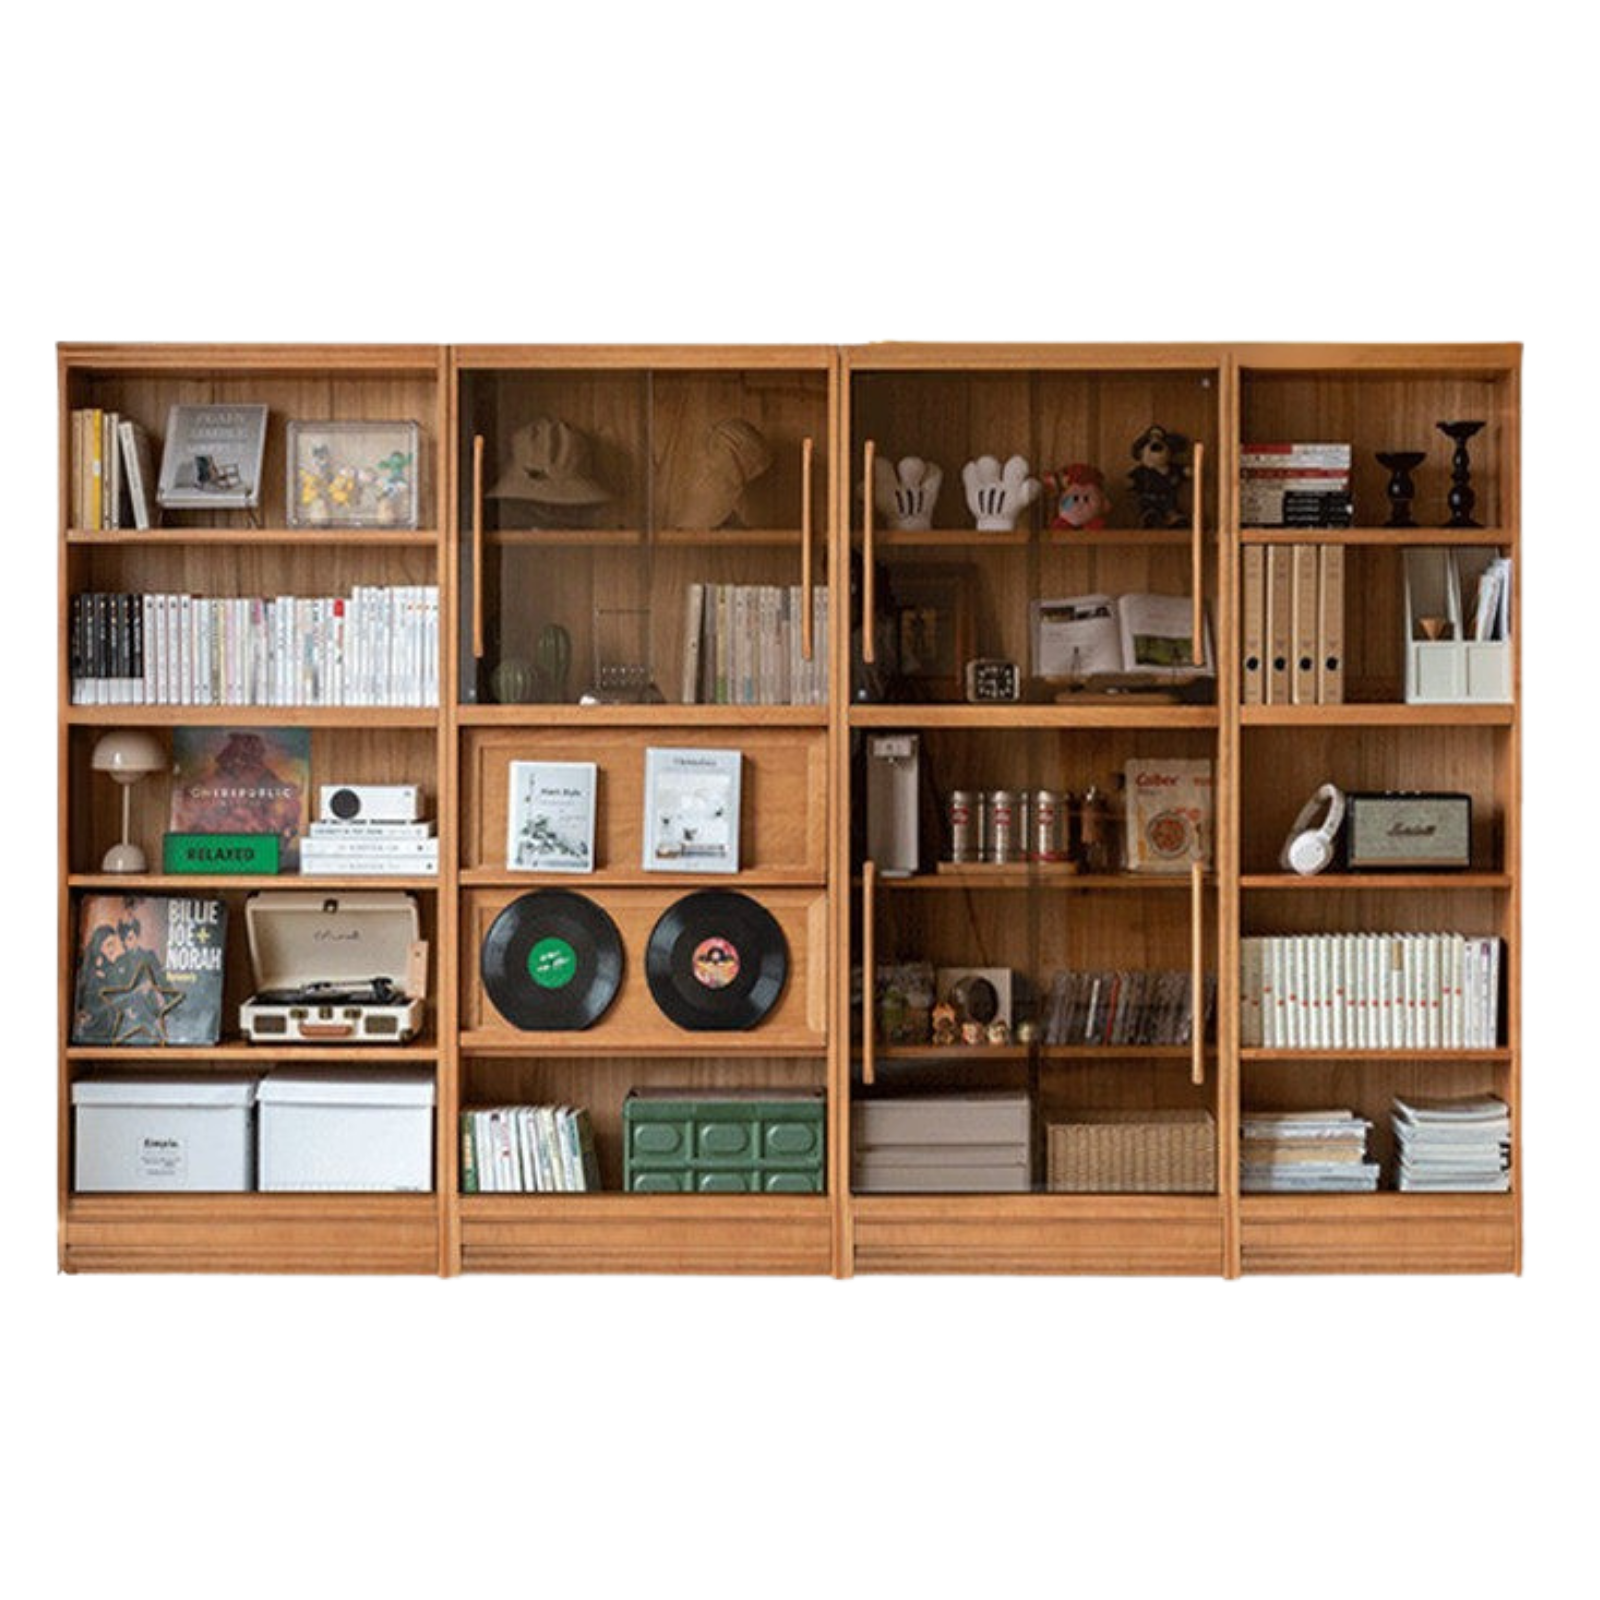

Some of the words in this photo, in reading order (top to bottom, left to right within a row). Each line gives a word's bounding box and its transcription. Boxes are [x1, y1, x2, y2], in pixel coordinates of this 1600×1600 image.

[187, 847, 255, 861] RELAXED
[167, 899, 219, 925] BILLIE
[165, 946, 222, 971] NORAH
